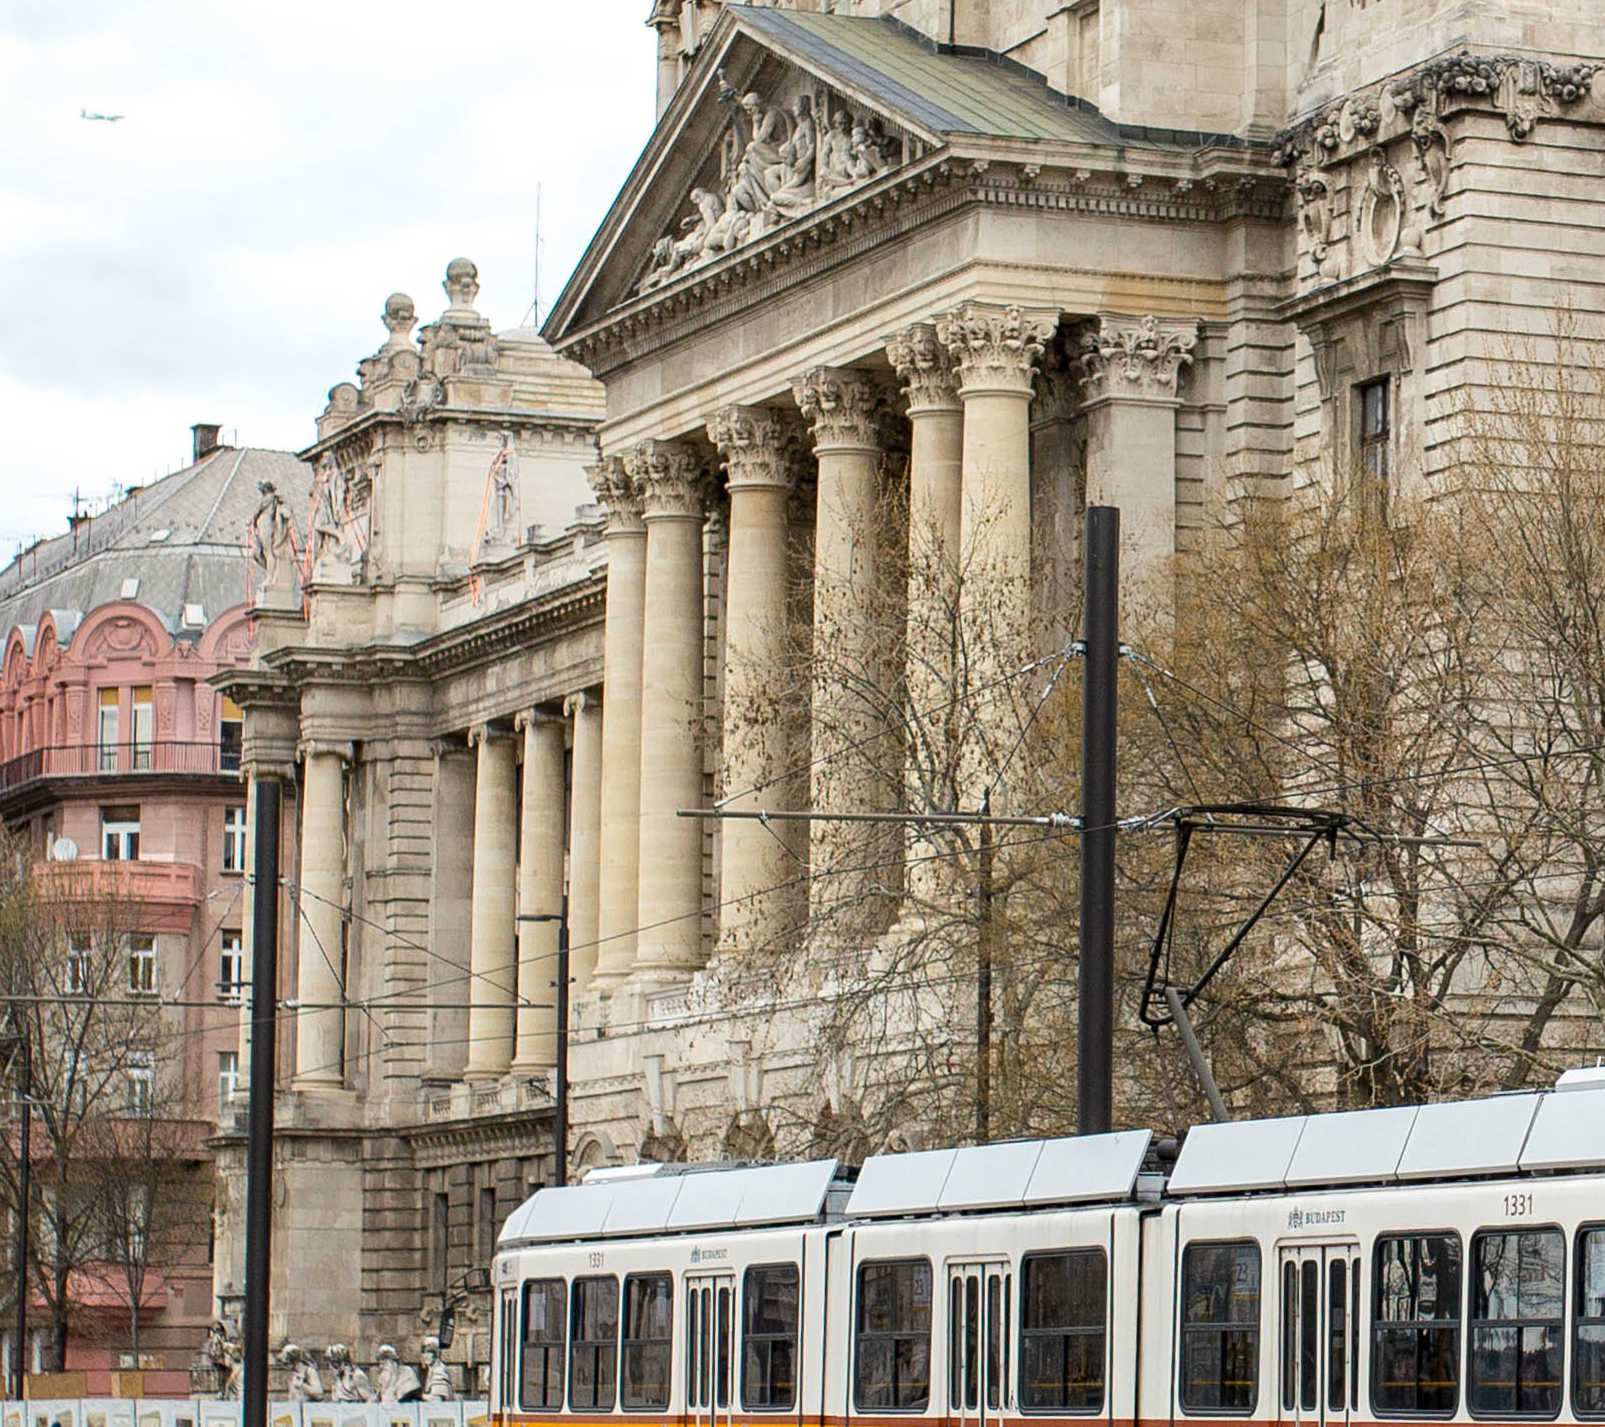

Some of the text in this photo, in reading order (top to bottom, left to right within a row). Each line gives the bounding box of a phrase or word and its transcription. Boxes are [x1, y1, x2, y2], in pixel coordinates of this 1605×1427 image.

[1504, 1193, 1533, 1216] 1331
[1305, 1210, 1346, 1224] BUDAPEST
[589, 1252, 604, 1269] 1331
